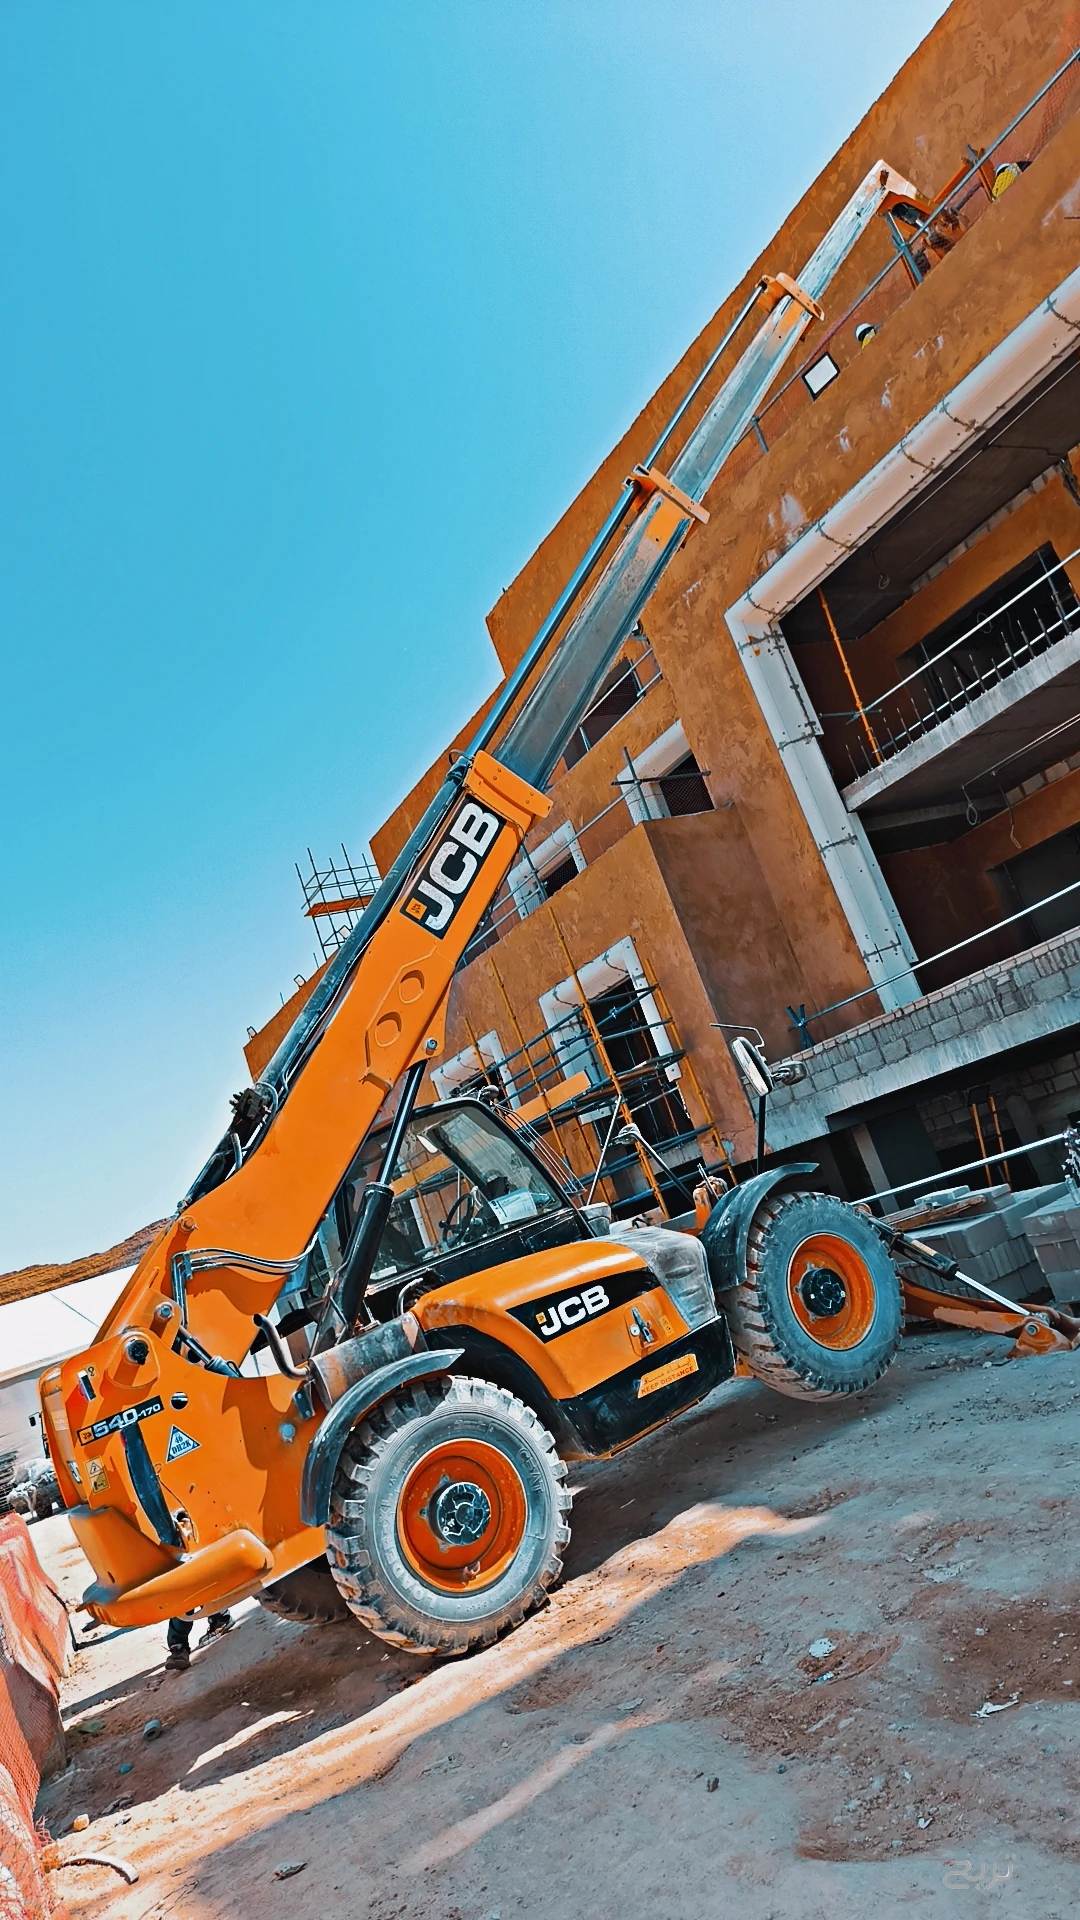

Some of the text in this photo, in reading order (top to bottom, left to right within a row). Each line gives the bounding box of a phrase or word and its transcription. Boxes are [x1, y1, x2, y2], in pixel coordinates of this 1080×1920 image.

[417, 802, 500, 931] JCB
[540, 1285, 610, 1336] JCB
[641, 1366, 694, 1395] KEEP DISTANCE
[93, 1403, 161, 1438] 540-170
